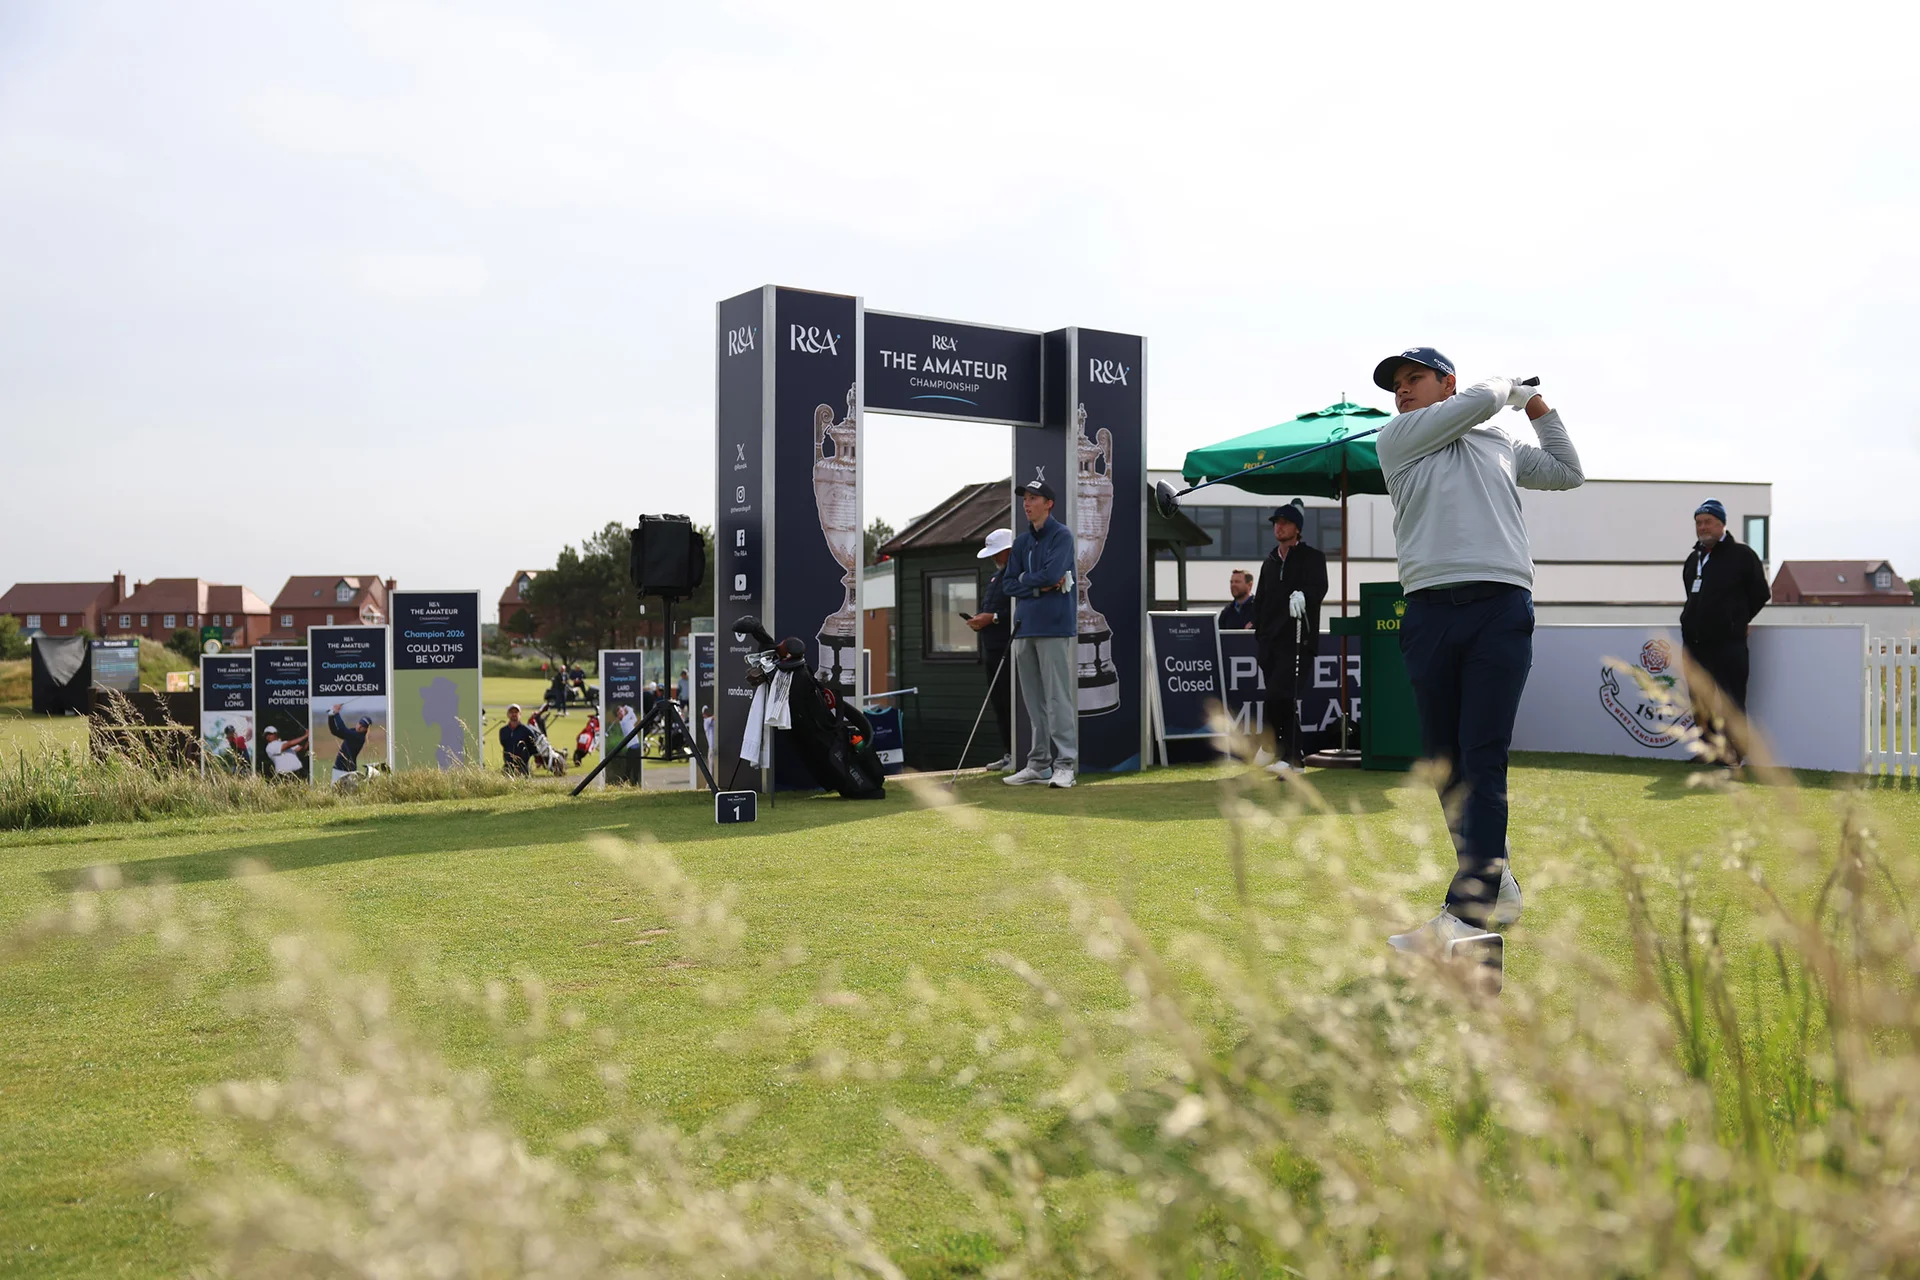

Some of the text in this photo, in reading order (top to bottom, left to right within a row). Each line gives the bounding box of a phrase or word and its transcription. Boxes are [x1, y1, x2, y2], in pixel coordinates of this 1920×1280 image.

[728, 325, 757, 356] R&A
[790, 324, 840, 356] R&A
[932, 334, 958, 351] R&A
[880, 350, 1008, 381] THE AMATEUR
[1089, 358, 1130, 386] R&A
[910, 377, 980, 392] CHAMPIONSHIP
[404, 630, 465, 639] Champion 2026
[406, 644, 463, 653] COULD THIS
[416, 655, 455, 664] BE YOU?
[1165, 656, 1213, 672] Course
[334, 674, 364, 682] JACOB
[1168, 676, 1214, 693] Closed
[272, 689, 305, 697] ALDRICH
[319, 683, 379, 692] SKOV OLESEN
[728, 687, 753, 699] randa.org
[224, 700, 245, 708] LONG
[268, 697, 309, 705] POTGIETER
[1615, 708, 1632, 725] WEST
[733, 806, 740, 820] 1
